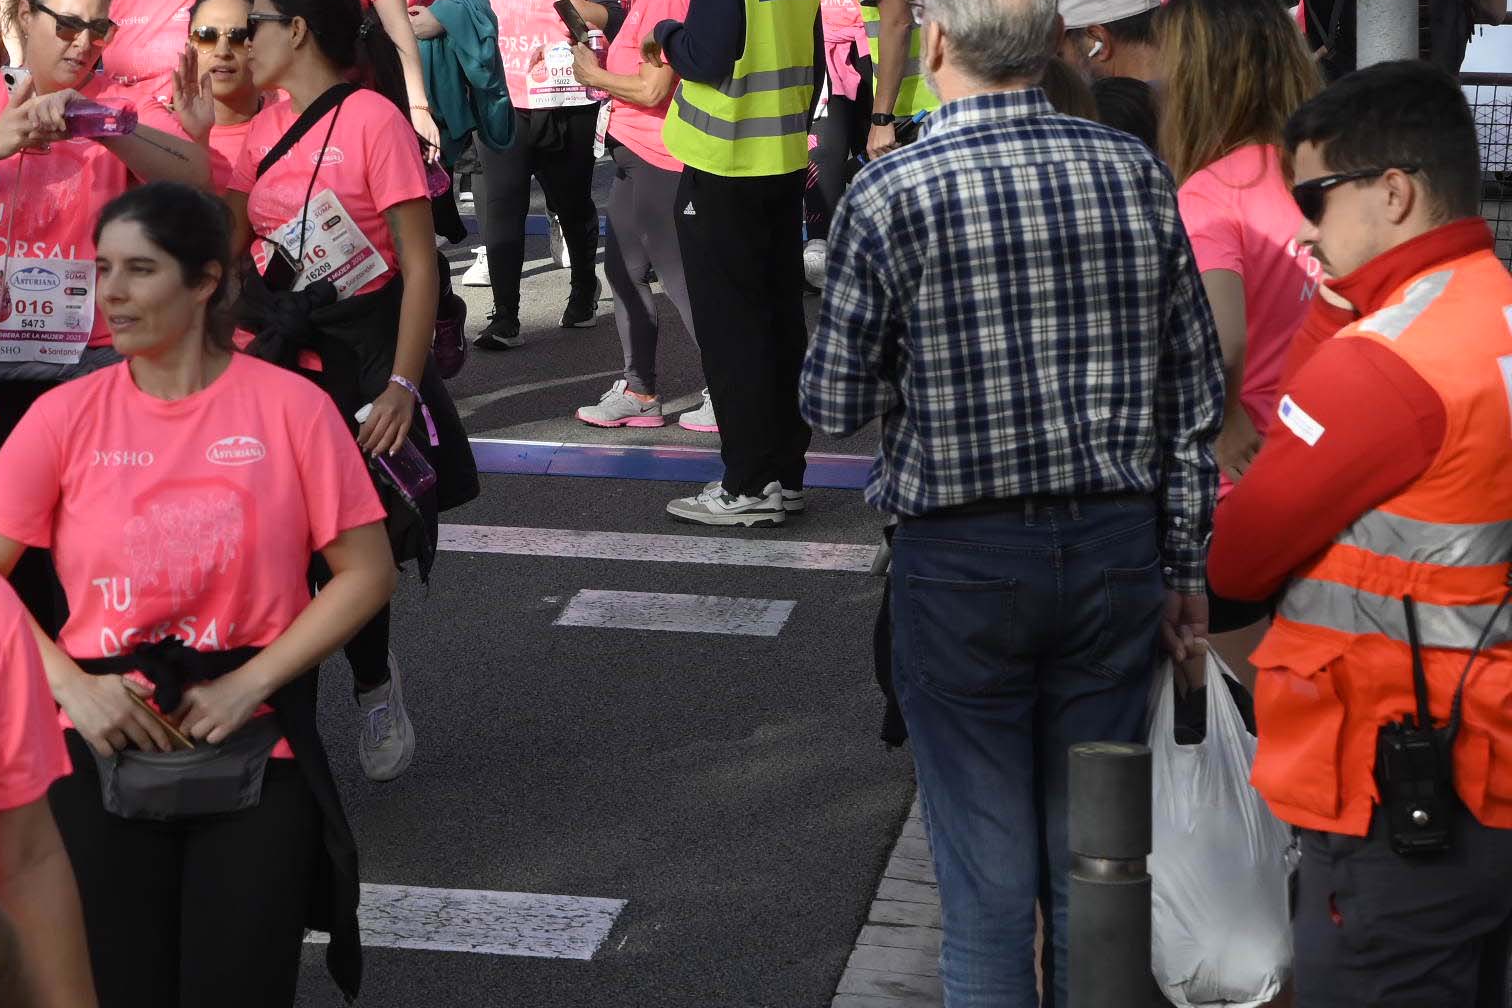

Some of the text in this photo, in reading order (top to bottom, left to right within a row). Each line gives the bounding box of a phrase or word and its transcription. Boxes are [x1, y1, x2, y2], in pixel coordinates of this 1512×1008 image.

[551, 67, 573, 77] 016
[303, 244, 328, 266] 16
[64, 272, 88, 281] SUMA
[304, 261, 333, 283] 16209
[14, 276, 58, 287] ASTURIANA
[15, 299, 54, 315] 016
[21, 318, 46, 329] 5473
[41, 333, 65, 341] MUJER
[209, 446, 263, 460] ASTURIANA
[91, 576, 133, 613] TU
